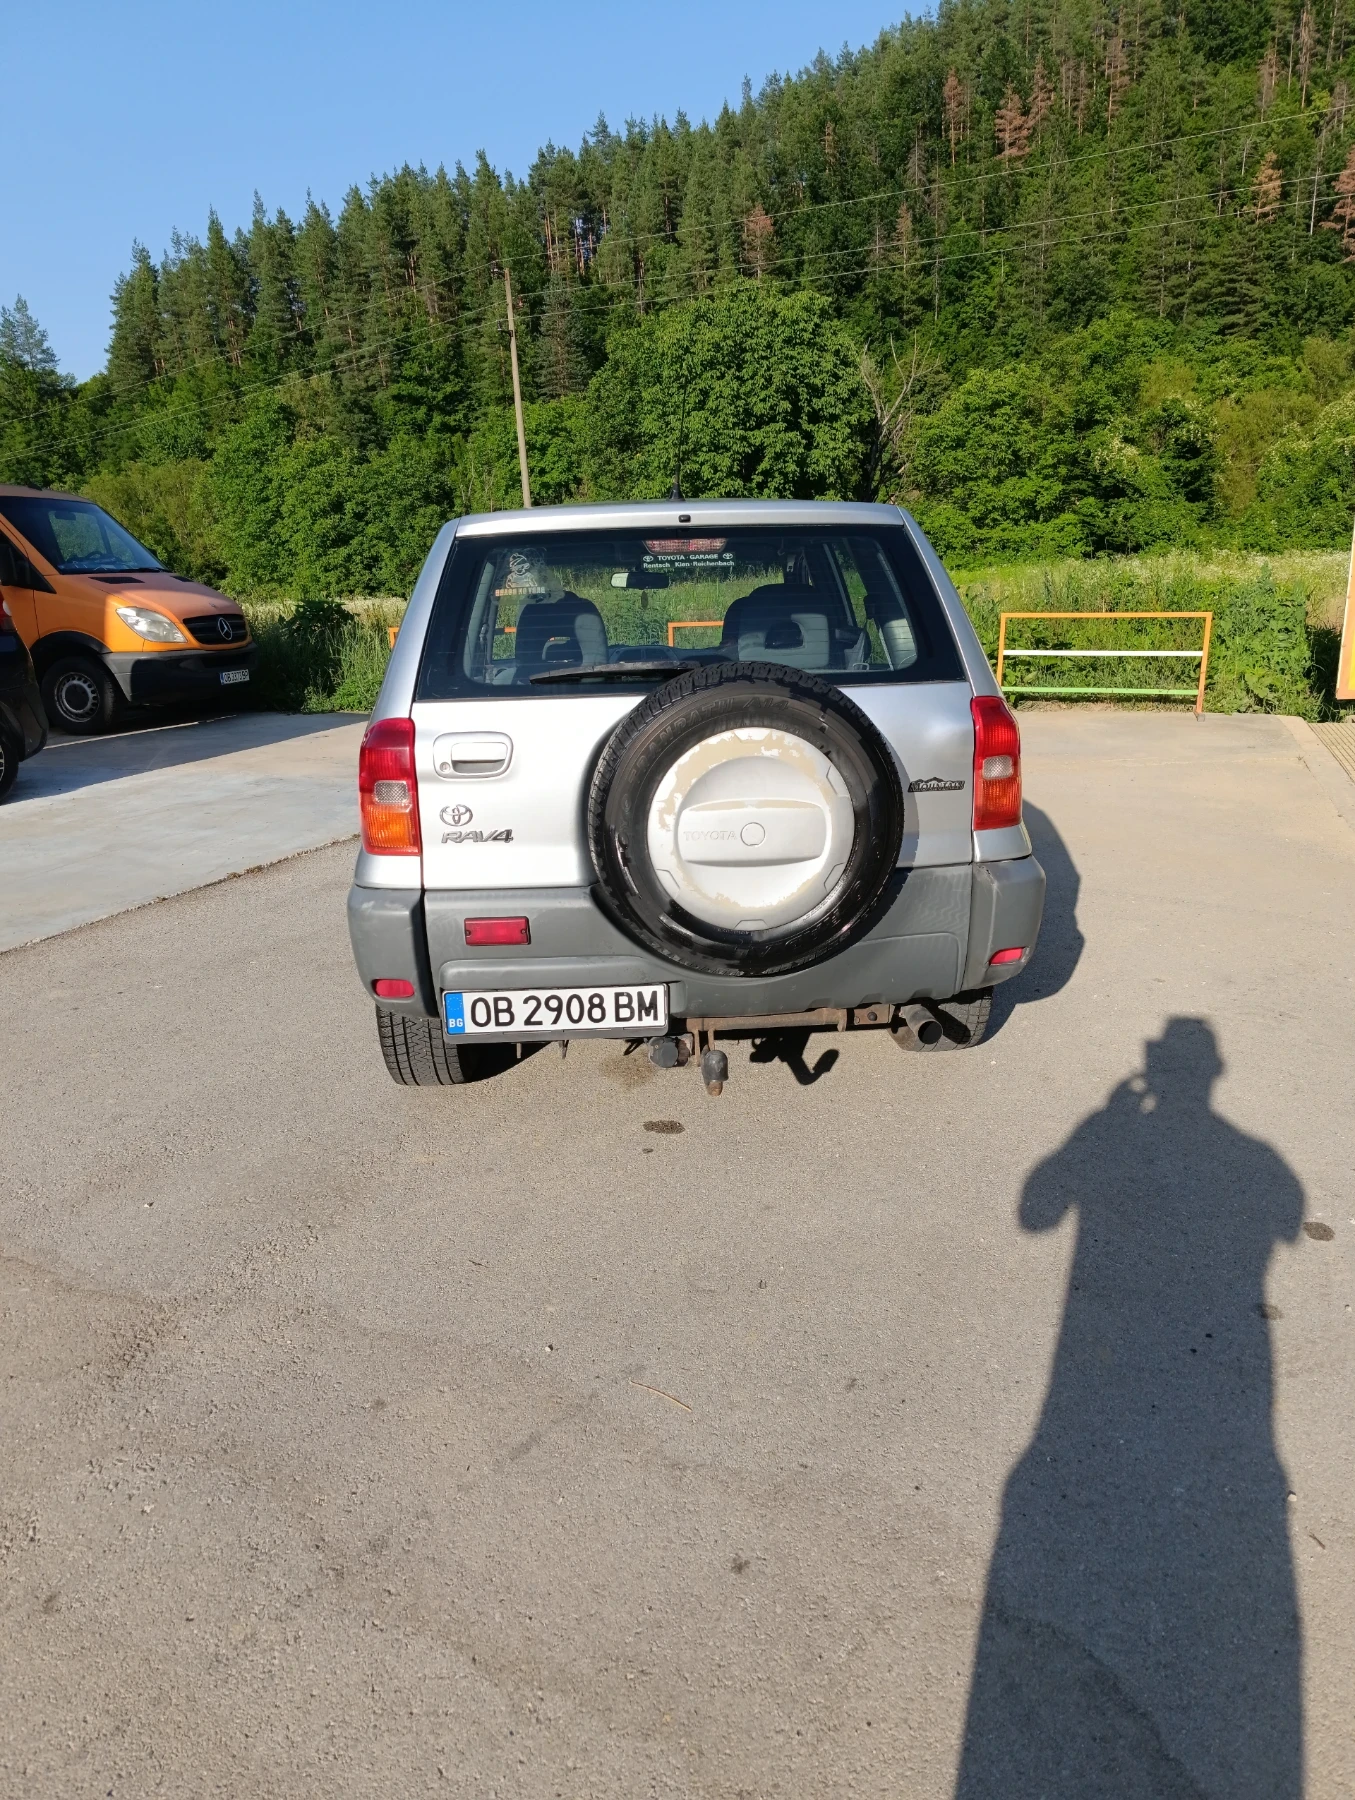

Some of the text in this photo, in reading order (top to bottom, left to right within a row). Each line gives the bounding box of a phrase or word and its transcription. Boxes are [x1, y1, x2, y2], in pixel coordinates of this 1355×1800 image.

[441, 829, 514, 843] RAV4
[683, 830, 738, 841] TOYOTA
[470, 990, 659, 1028] OB 2908 BM
[449, 1018, 464, 1028] BG
